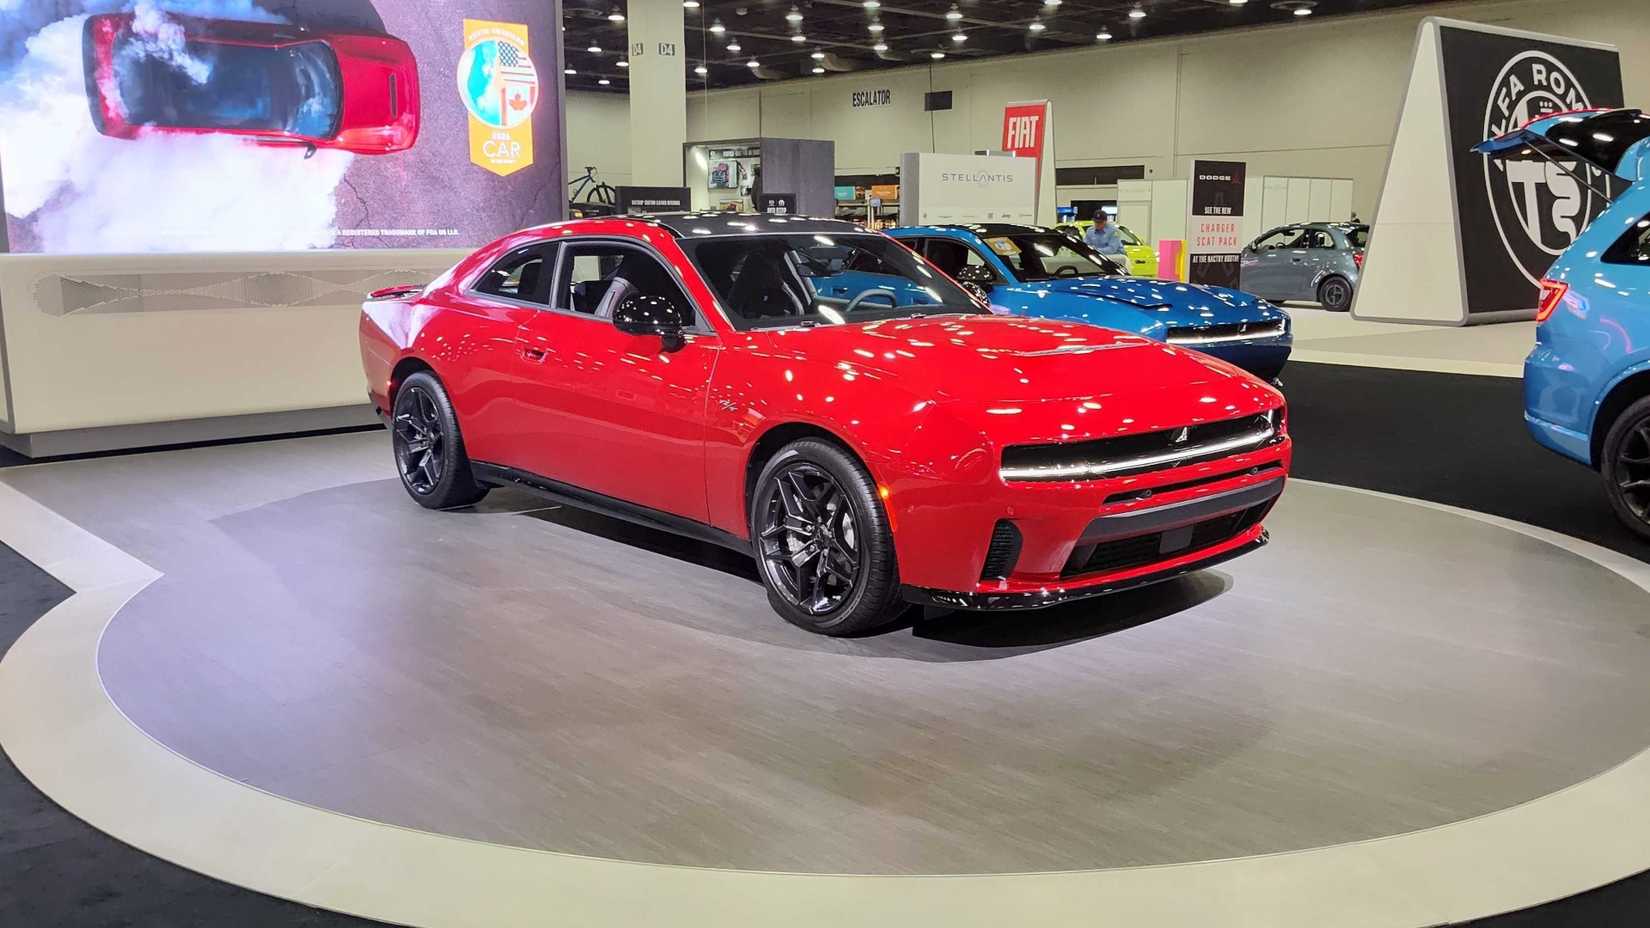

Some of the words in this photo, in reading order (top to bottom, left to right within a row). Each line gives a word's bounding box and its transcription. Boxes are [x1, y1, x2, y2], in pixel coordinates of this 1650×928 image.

[659, 43, 676, 56] D4
[852, 89, 891, 107] ESCALATOR
[1007, 115, 1040, 149] FIAT
[483, 140, 520, 158] CAR
[941, 173, 1014, 183] STELLANTIS
[1204, 206, 1213, 214] SEE
[1213, 206, 1221, 214] THE
[342, 228, 380, 236] REGISTERED
[417, 228, 425, 236] OF
[1200, 223, 1234, 233] CHARGER
[1196, 236, 1216, 247] SCAT
[1217, 236, 1237, 247] PACK
